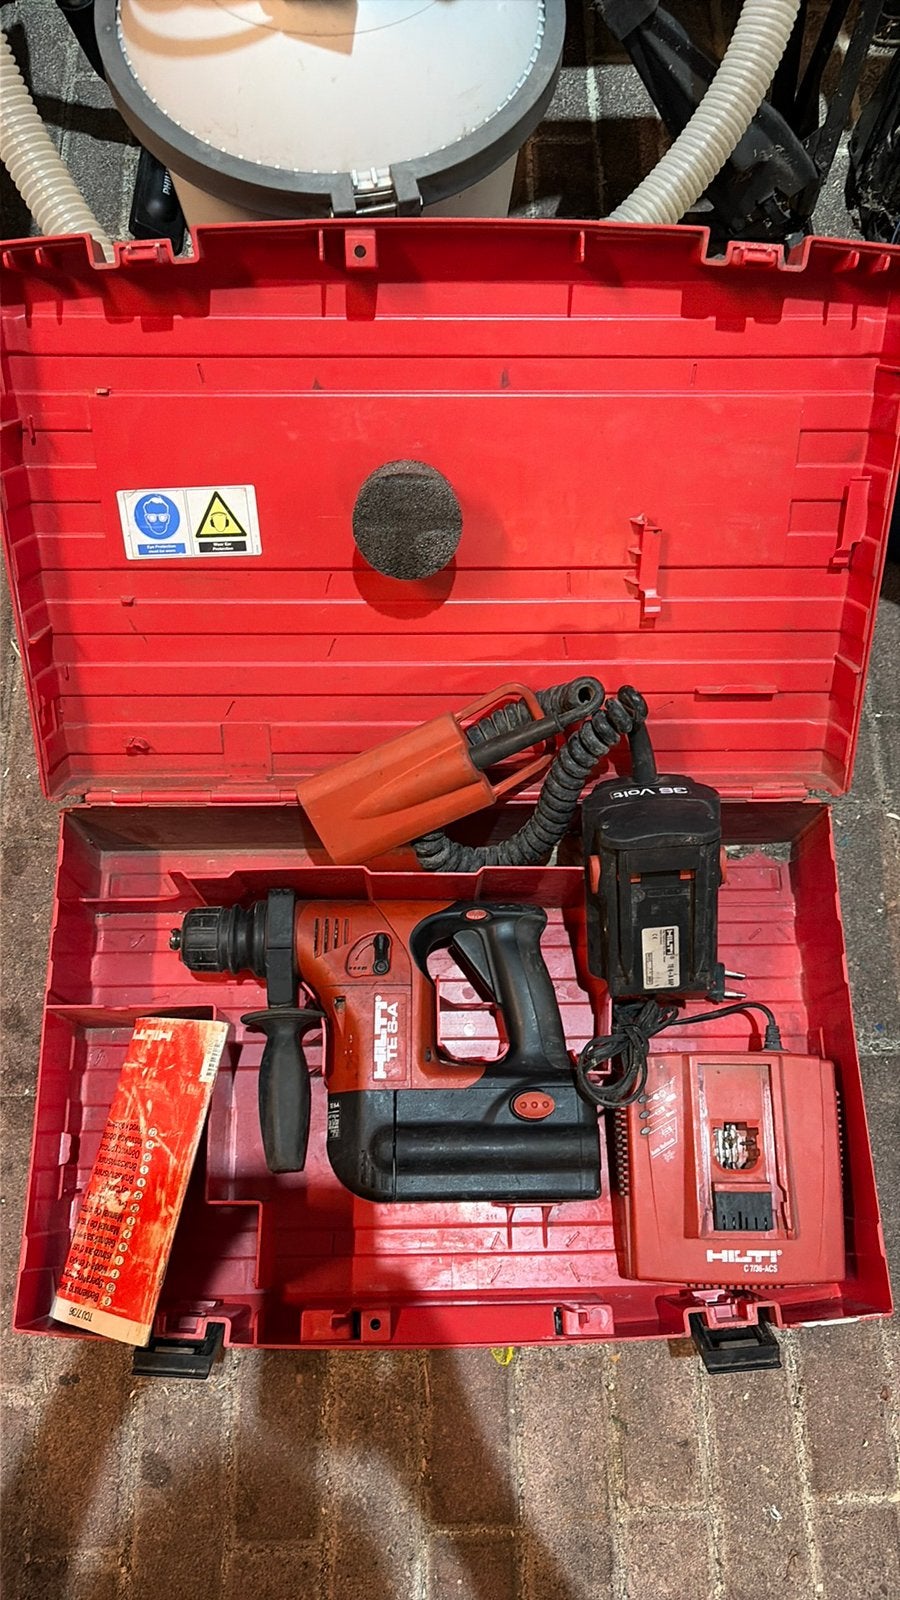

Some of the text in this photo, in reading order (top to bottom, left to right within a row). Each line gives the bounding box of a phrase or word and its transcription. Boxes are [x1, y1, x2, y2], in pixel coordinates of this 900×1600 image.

[612, 788, 656, 800] Volt
[664, 929, 675, 955] HILTI
[374, 1002, 388, 1080] HILTI
[386, 1038, 398, 1062] TE
[706, 1250, 777, 1262] HILTI
[744, 1264, 750, 1272] C
